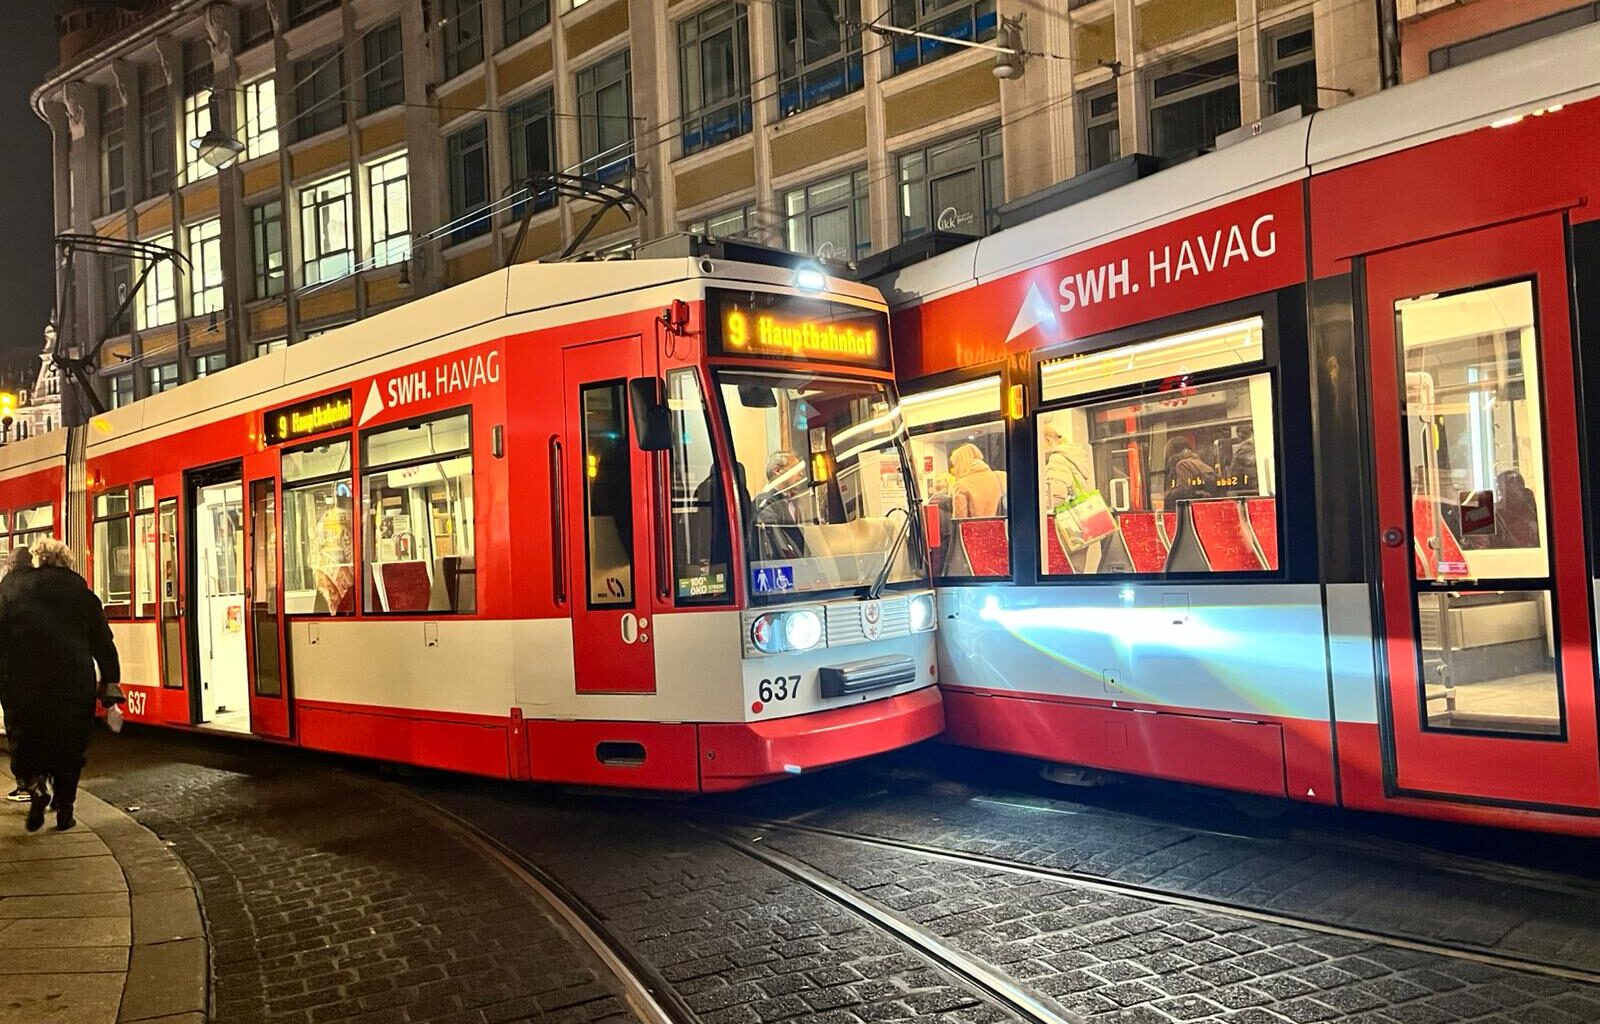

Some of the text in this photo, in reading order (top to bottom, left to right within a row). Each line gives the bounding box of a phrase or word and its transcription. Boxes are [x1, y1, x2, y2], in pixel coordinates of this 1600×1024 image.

[1059, 214, 1276, 313] SWH. HAVAG
[728, 312, 874, 355] 9 Hauptbahnhof
[388, 350, 500, 408] SWH. HAVAG
[279, 416, 287, 439] 9
[128, 690, 147, 716] 637
[759, 674, 802, 703] 637
